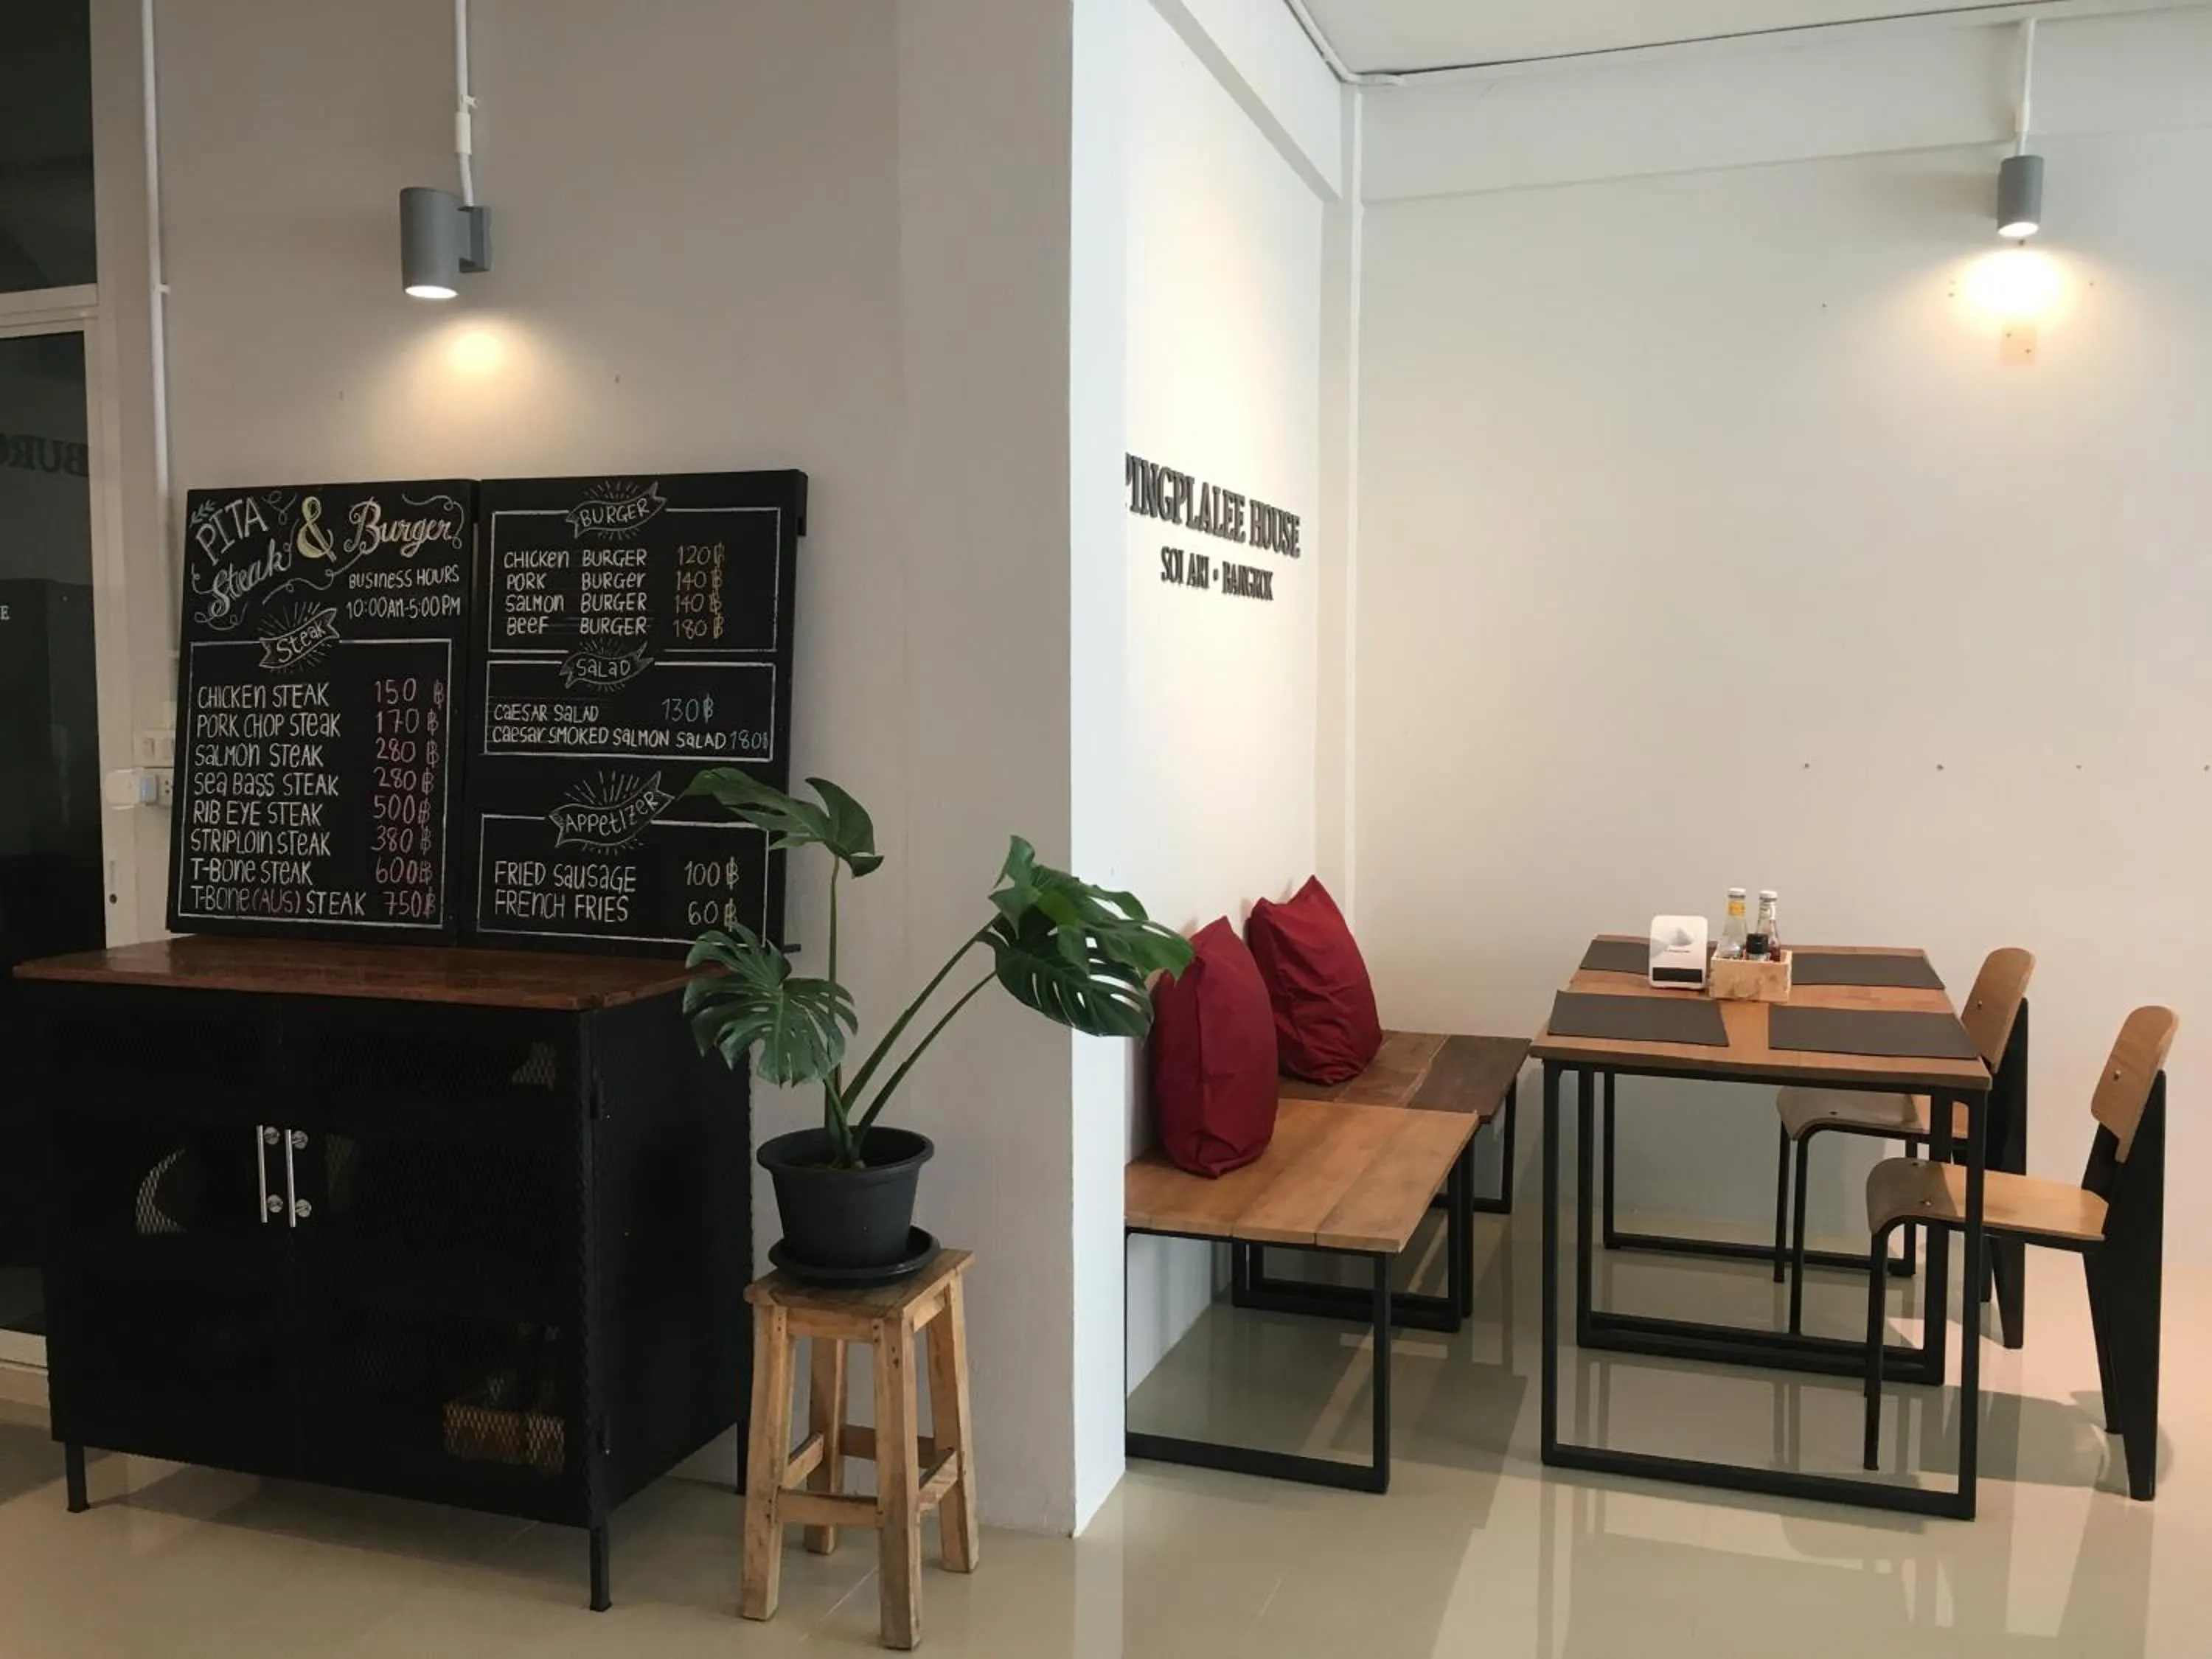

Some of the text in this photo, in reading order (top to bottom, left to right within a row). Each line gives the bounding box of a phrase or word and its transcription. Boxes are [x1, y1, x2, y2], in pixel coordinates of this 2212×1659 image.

[580, 498, 650, 527] BURGER
[195, 496, 269, 566] PITA
[298, 496, 452, 561] & Burger
[1249, 498, 1301, 559] HOUSE
[582, 548, 647, 568] BURGER
[209, 538, 288, 617] Steak
[417, 564, 460, 586] HOURS
[507, 572, 547, 592] PORK
[1161, 546, 1184, 585] SOI
[1222, 560, 1274, 601] BANGKOK
[580, 592, 647, 613] BURGER
[580, 616, 647, 636] BURGER
[272, 682, 330, 709] STEAK
[197, 713, 240, 738] PORK
[243, 713, 285, 739] CHOP
[548, 726, 609, 745] SMOKED
[282, 772, 339, 797] STEAK
[193, 800, 220, 824] RIB
[226, 801, 261, 826] EYE
[268, 801, 322, 827] STEAK
[495, 860, 546, 887] FRIED
[306, 890, 366, 917] STEAK
[574, 894, 629, 922] FRIES
